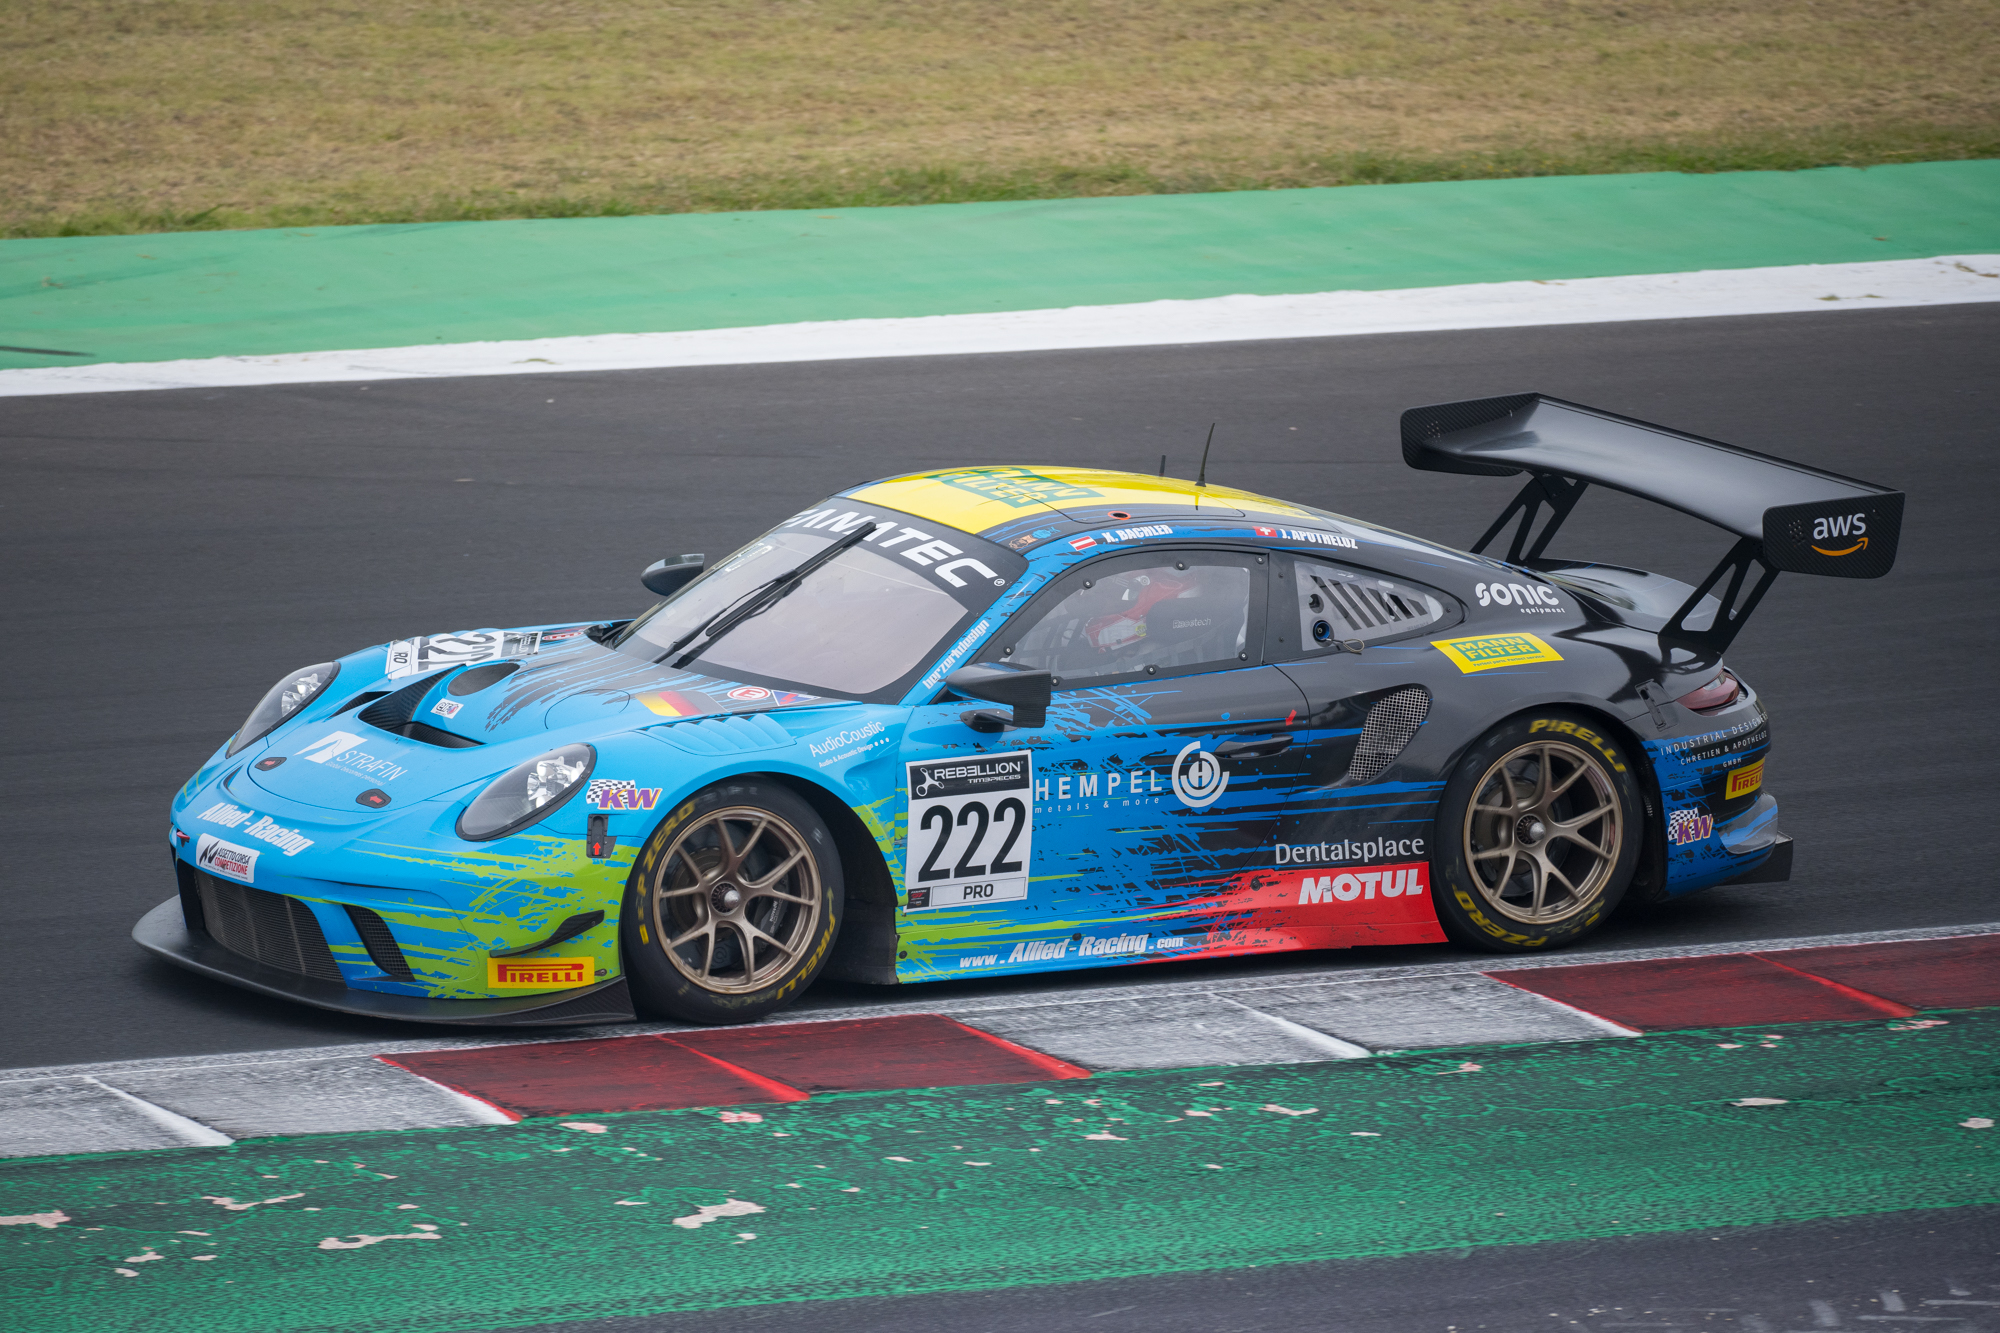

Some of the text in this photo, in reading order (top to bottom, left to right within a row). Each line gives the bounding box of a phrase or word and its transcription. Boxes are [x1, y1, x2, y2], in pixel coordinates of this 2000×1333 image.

[1101, 525, 1173, 543] K. BACHLER
[1280, 529, 1358, 549] J. APOTHELOZ
[1813, 513, 1867, 539] aws
[922, 620, 990, 689] berzerkdesign
[1455, 637, 1525, 651] MANN
[1465, 644, 1535, 659] FILTER
[809, 721, 885, 757] AudioCoustic
[1529, 719, 1627, 773] PIRELLI
[1661, 730, 1727, 756] INDUSTRIAL
[1680, 747, 1721, 765] CHRETIEN
[1732, 730, 1767, 750] APOTHELOZ
[336, 750, 408, 781] STRAFIN
[934, 761, 1021, 780] REBELLION
[1722, 757, 1742, 768] GMBH
[1035, 770, 1162, 801] HEMPEL
[598, 788, 662, 810] KW
[1035, 796, 1159, 814] metals & more
[918, 797, 1026, 883] 222
[1676, 814, 1714, 845] KW
[1275, 837, 1425, 865] Dentalsplace
[963, 883, 994, 900] PRO
[1298, 868, 1424, 905] MOTUL
[776, 913, 836, 1001] PIRELLI
[498, 963, 584, 983] PIRELLI
